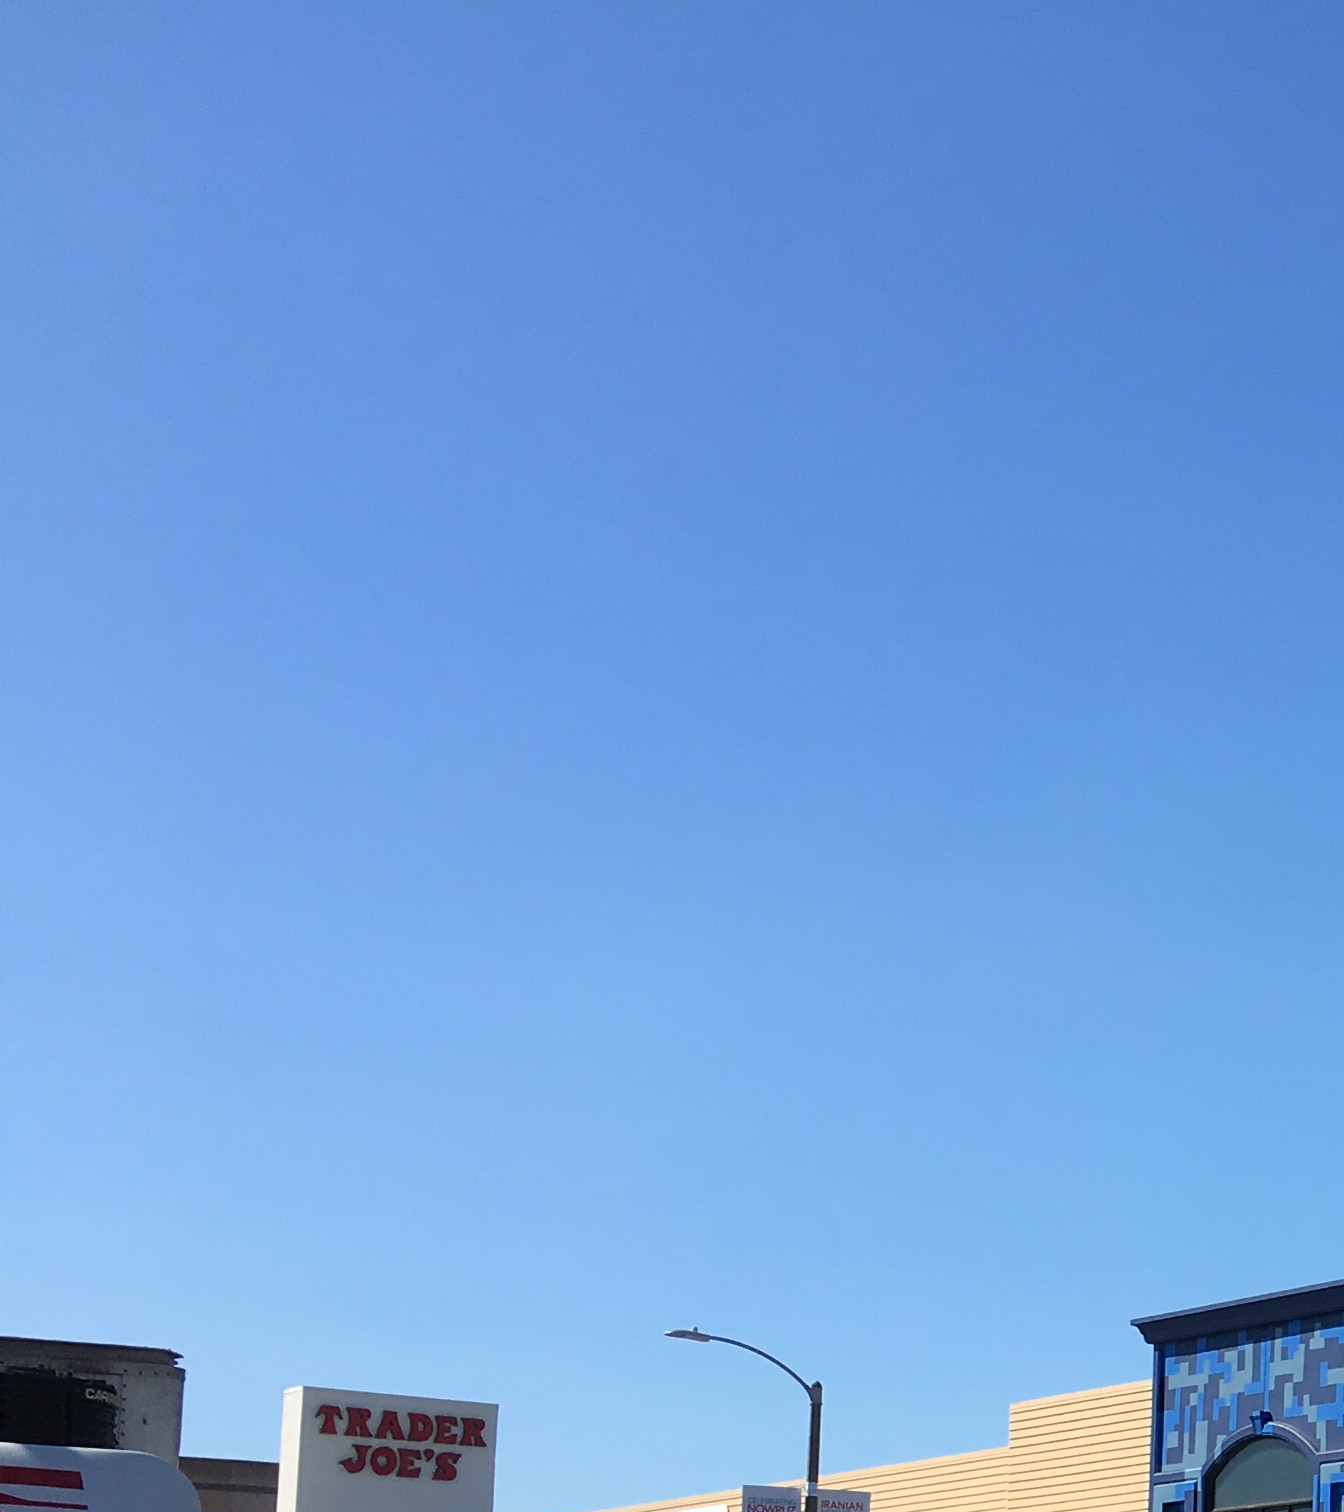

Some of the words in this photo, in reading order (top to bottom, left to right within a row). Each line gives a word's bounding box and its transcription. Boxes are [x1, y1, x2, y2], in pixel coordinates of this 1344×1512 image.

[315, 1404, 487, 1448] TRADER
[339, 1443, 463, 1481] JOE'S
[821, 1500, 864, 1512] IRANIAN
